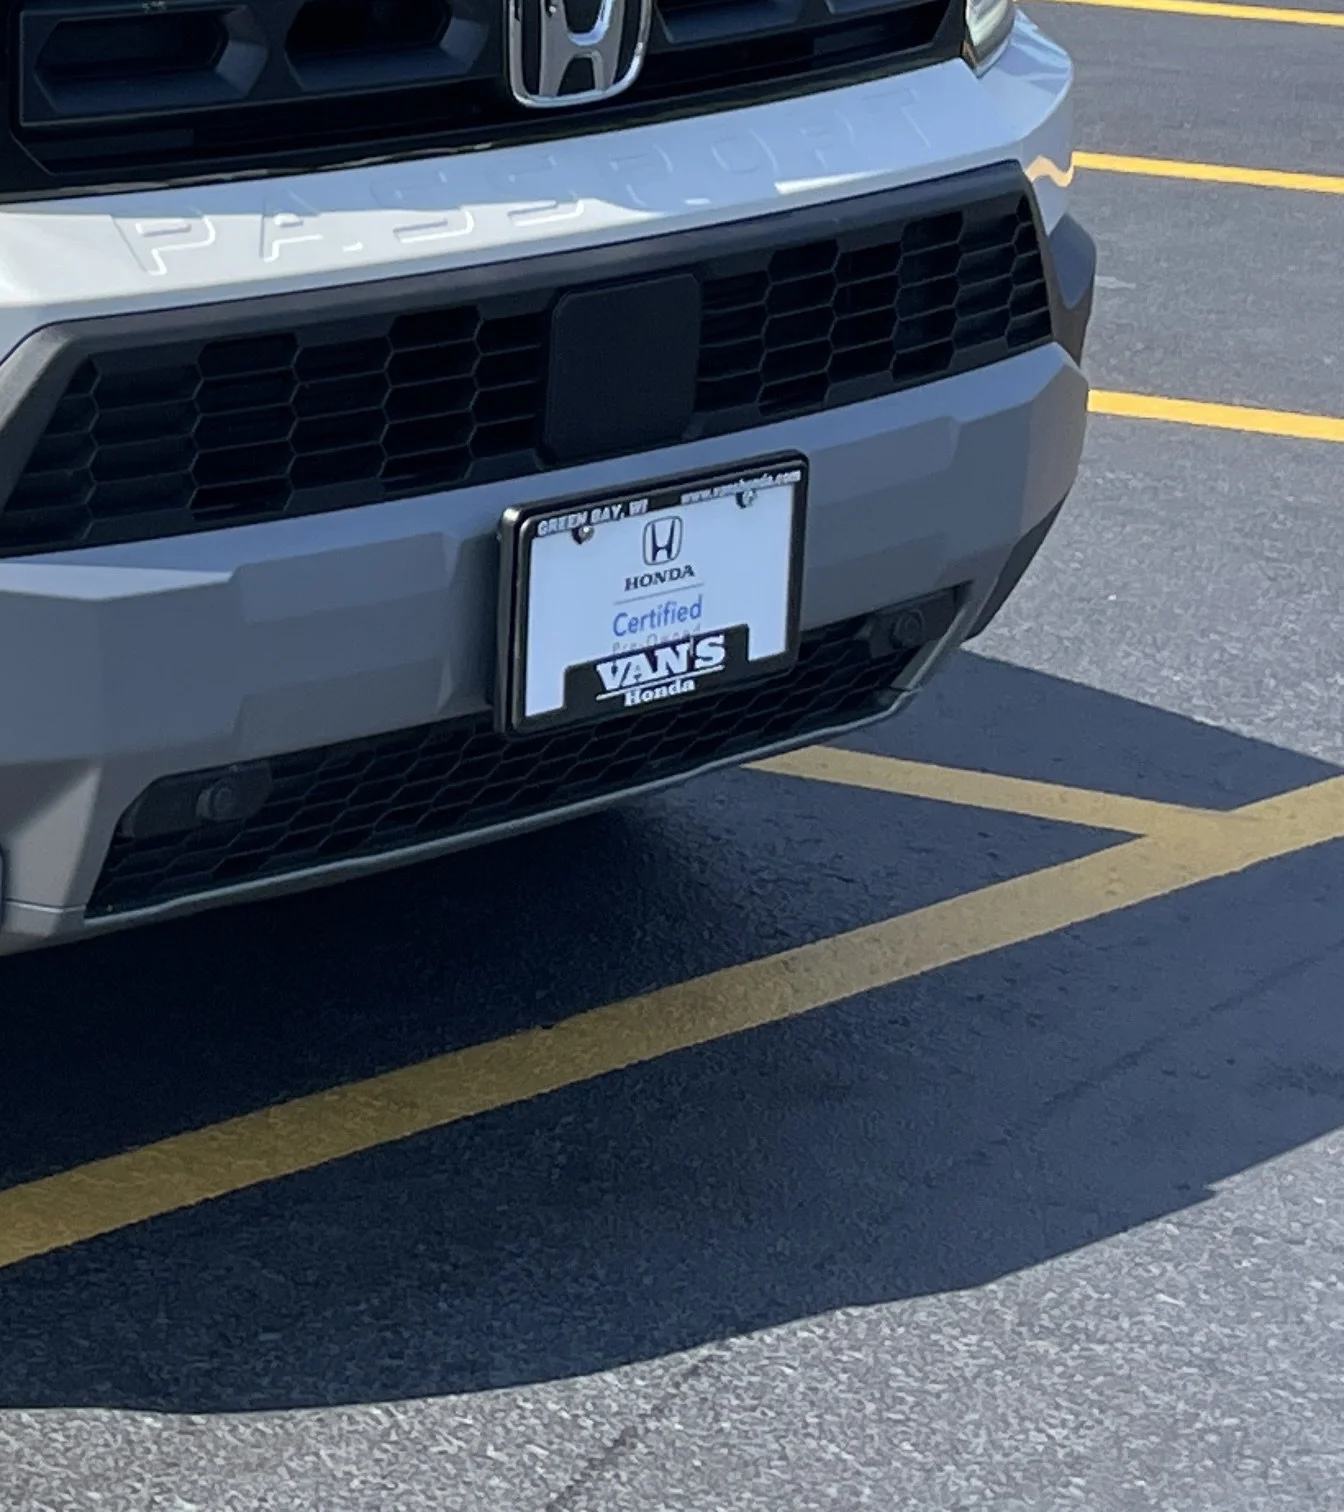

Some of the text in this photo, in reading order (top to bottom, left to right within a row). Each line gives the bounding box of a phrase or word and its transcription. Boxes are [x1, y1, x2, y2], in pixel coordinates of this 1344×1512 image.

[537, 510, 588, 538] GREEN
[623, 564, 696, 592] HONDA
[612, 594, 703, 637] Certified
[623, 678, 696, 707] Honda
